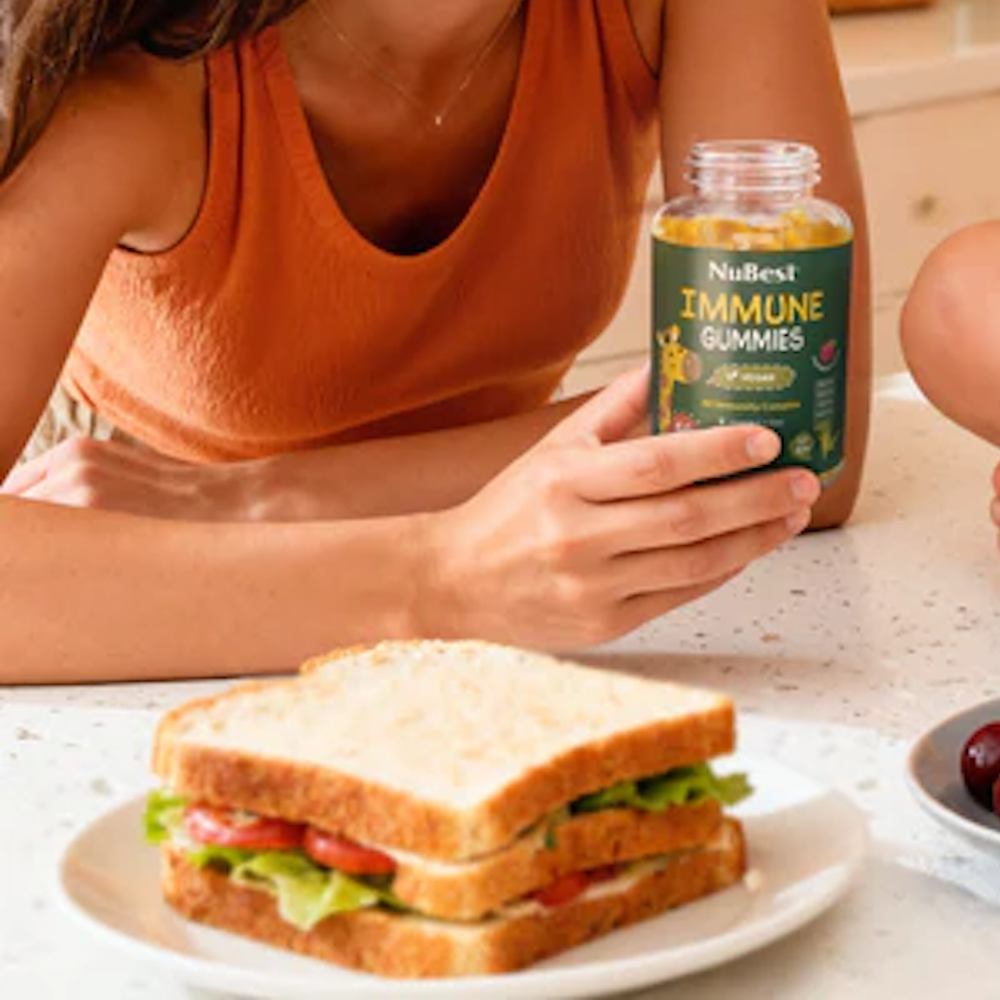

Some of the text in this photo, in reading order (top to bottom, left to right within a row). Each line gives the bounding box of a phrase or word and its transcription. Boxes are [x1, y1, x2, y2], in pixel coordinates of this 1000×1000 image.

[708, 261, 797, 283] NuBest
[680, 287, 824, 325] IMMUNE
[701, 325, 804, 351] GUMMIES
